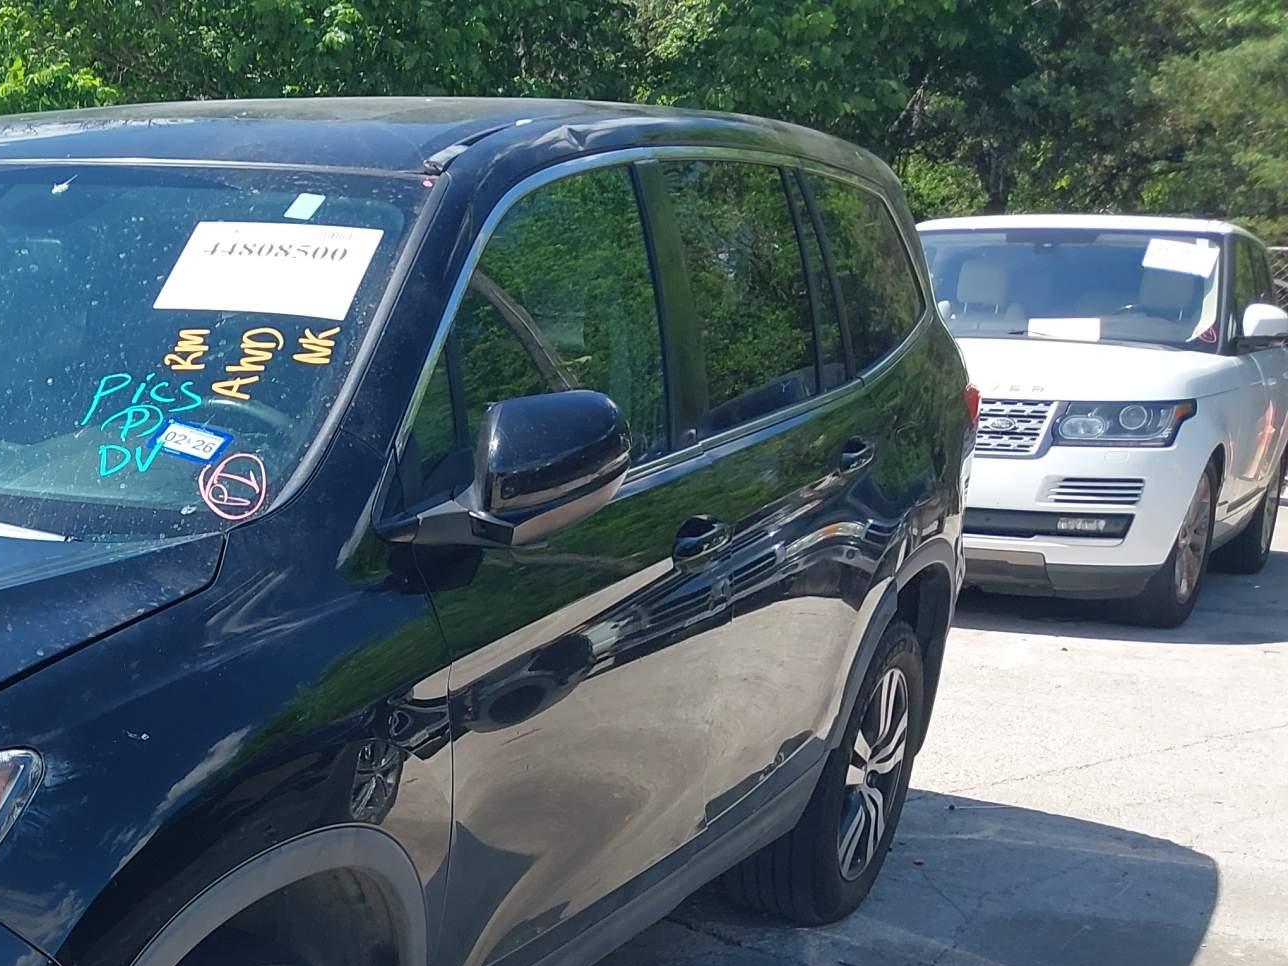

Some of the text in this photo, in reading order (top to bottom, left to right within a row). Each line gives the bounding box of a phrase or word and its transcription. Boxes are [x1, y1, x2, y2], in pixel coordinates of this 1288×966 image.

[203, 241, 348, 262] 44808500
[163, 328, 210, 371] RM
[99, 442, 165, 477] DV
